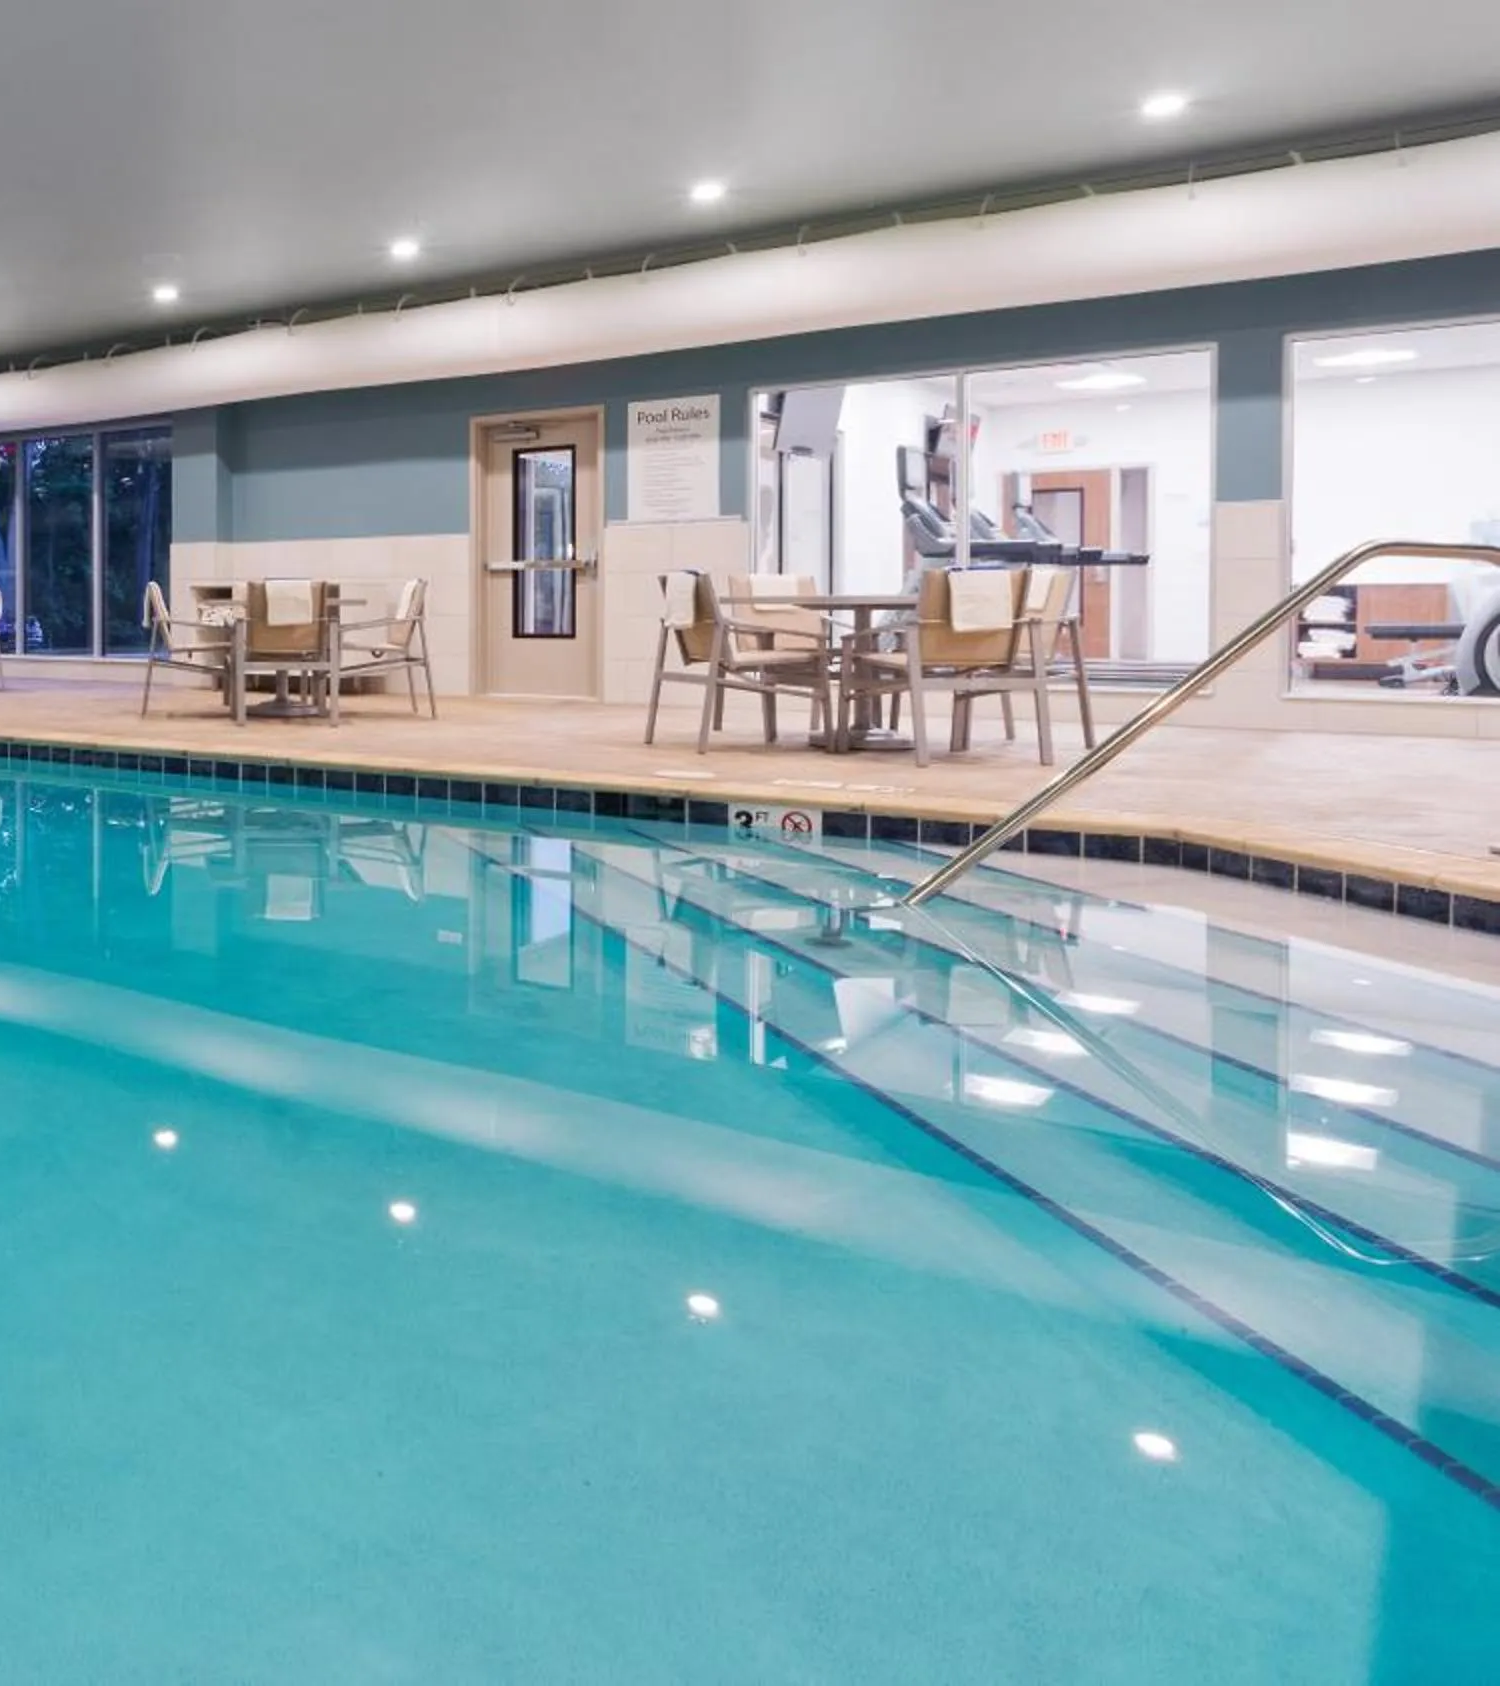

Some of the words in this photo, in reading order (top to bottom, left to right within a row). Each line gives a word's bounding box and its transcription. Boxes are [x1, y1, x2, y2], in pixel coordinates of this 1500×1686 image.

[637, 409, 667, 425] Pool
[671, 406, 710, 421] Rules
[755, 811, 769, 823] FT
